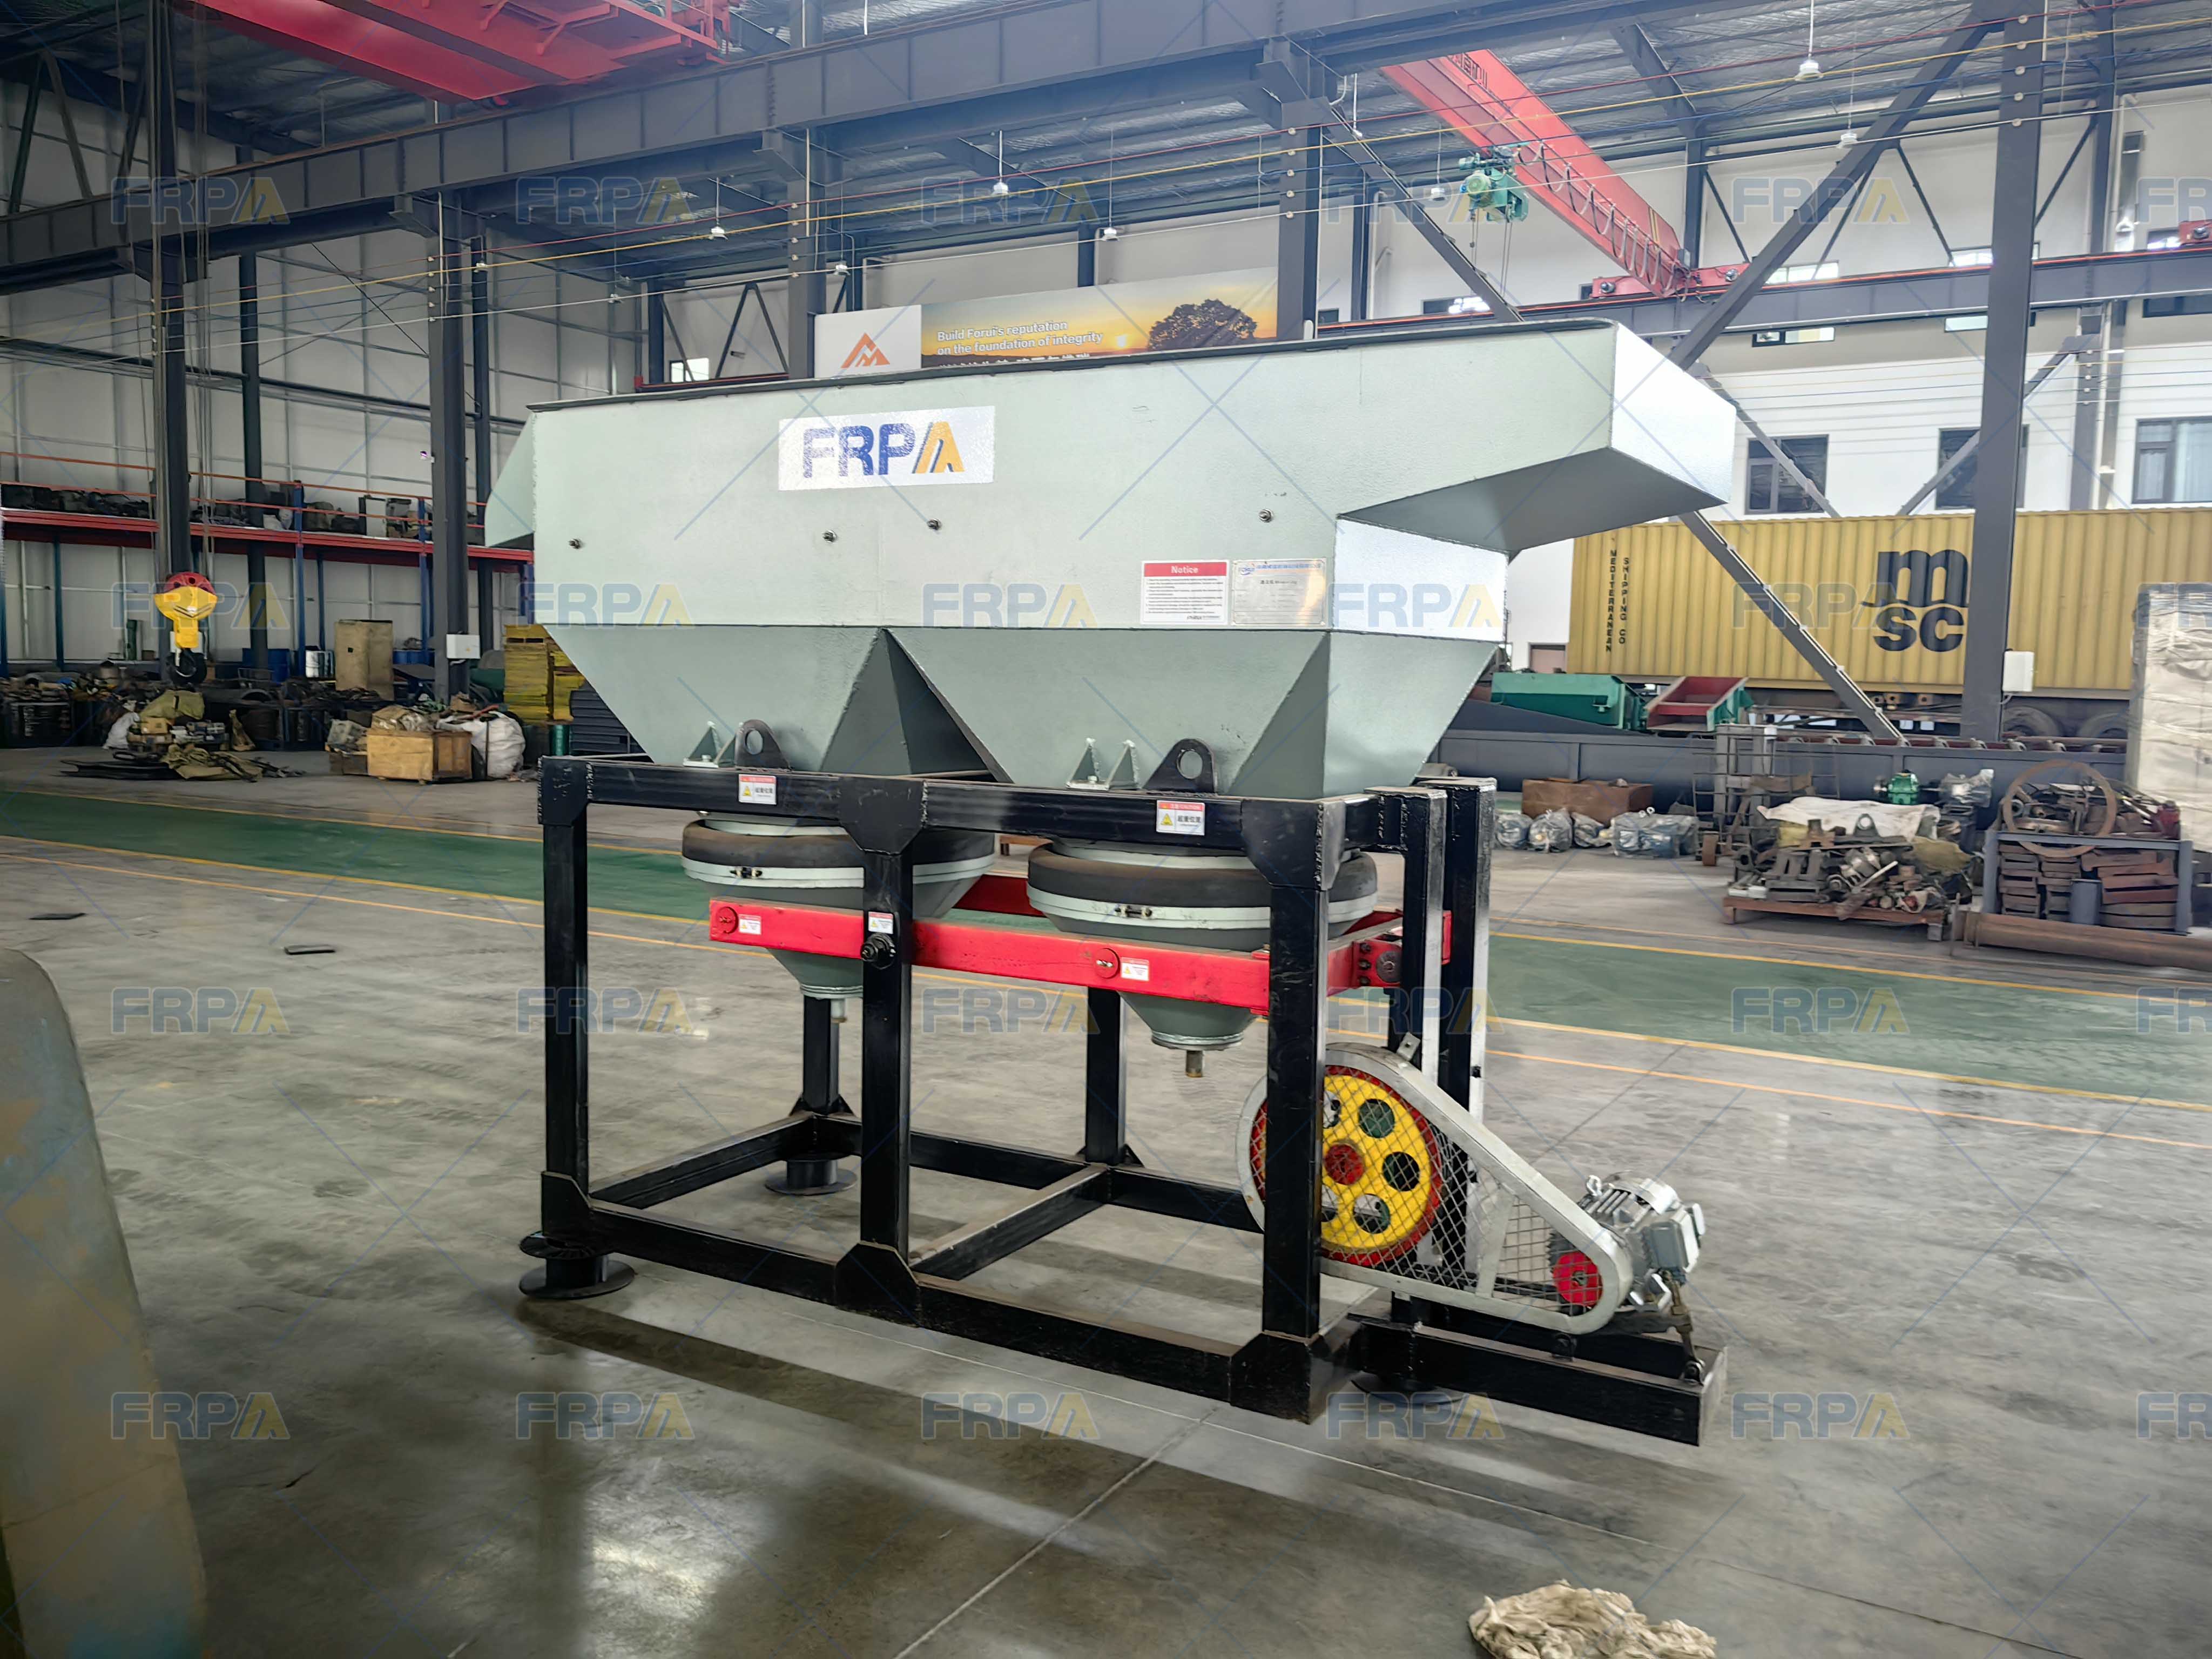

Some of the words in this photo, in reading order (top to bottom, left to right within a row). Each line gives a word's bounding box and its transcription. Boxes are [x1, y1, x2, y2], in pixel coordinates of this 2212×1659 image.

[938, 329, 965, 342] Build
[967, 326, 1004, 338] Forui's
[1007, 321, 1068, 336] reputation
[938, 346, 951, 355] on
[954, 343, 972, 354] the
[974, 339, 1036, 352] foundation
[1038, 335, 1050, 346] of
[1053, 332, 1103, 346] integrity
[802, 421, 966, 478] FRPA
[1171, 565, 1198, 574] Notice
[1620, 557, 1629, 621] SHIPPING
[1606, 550, 1616, 652] MEDITERRANEAN
